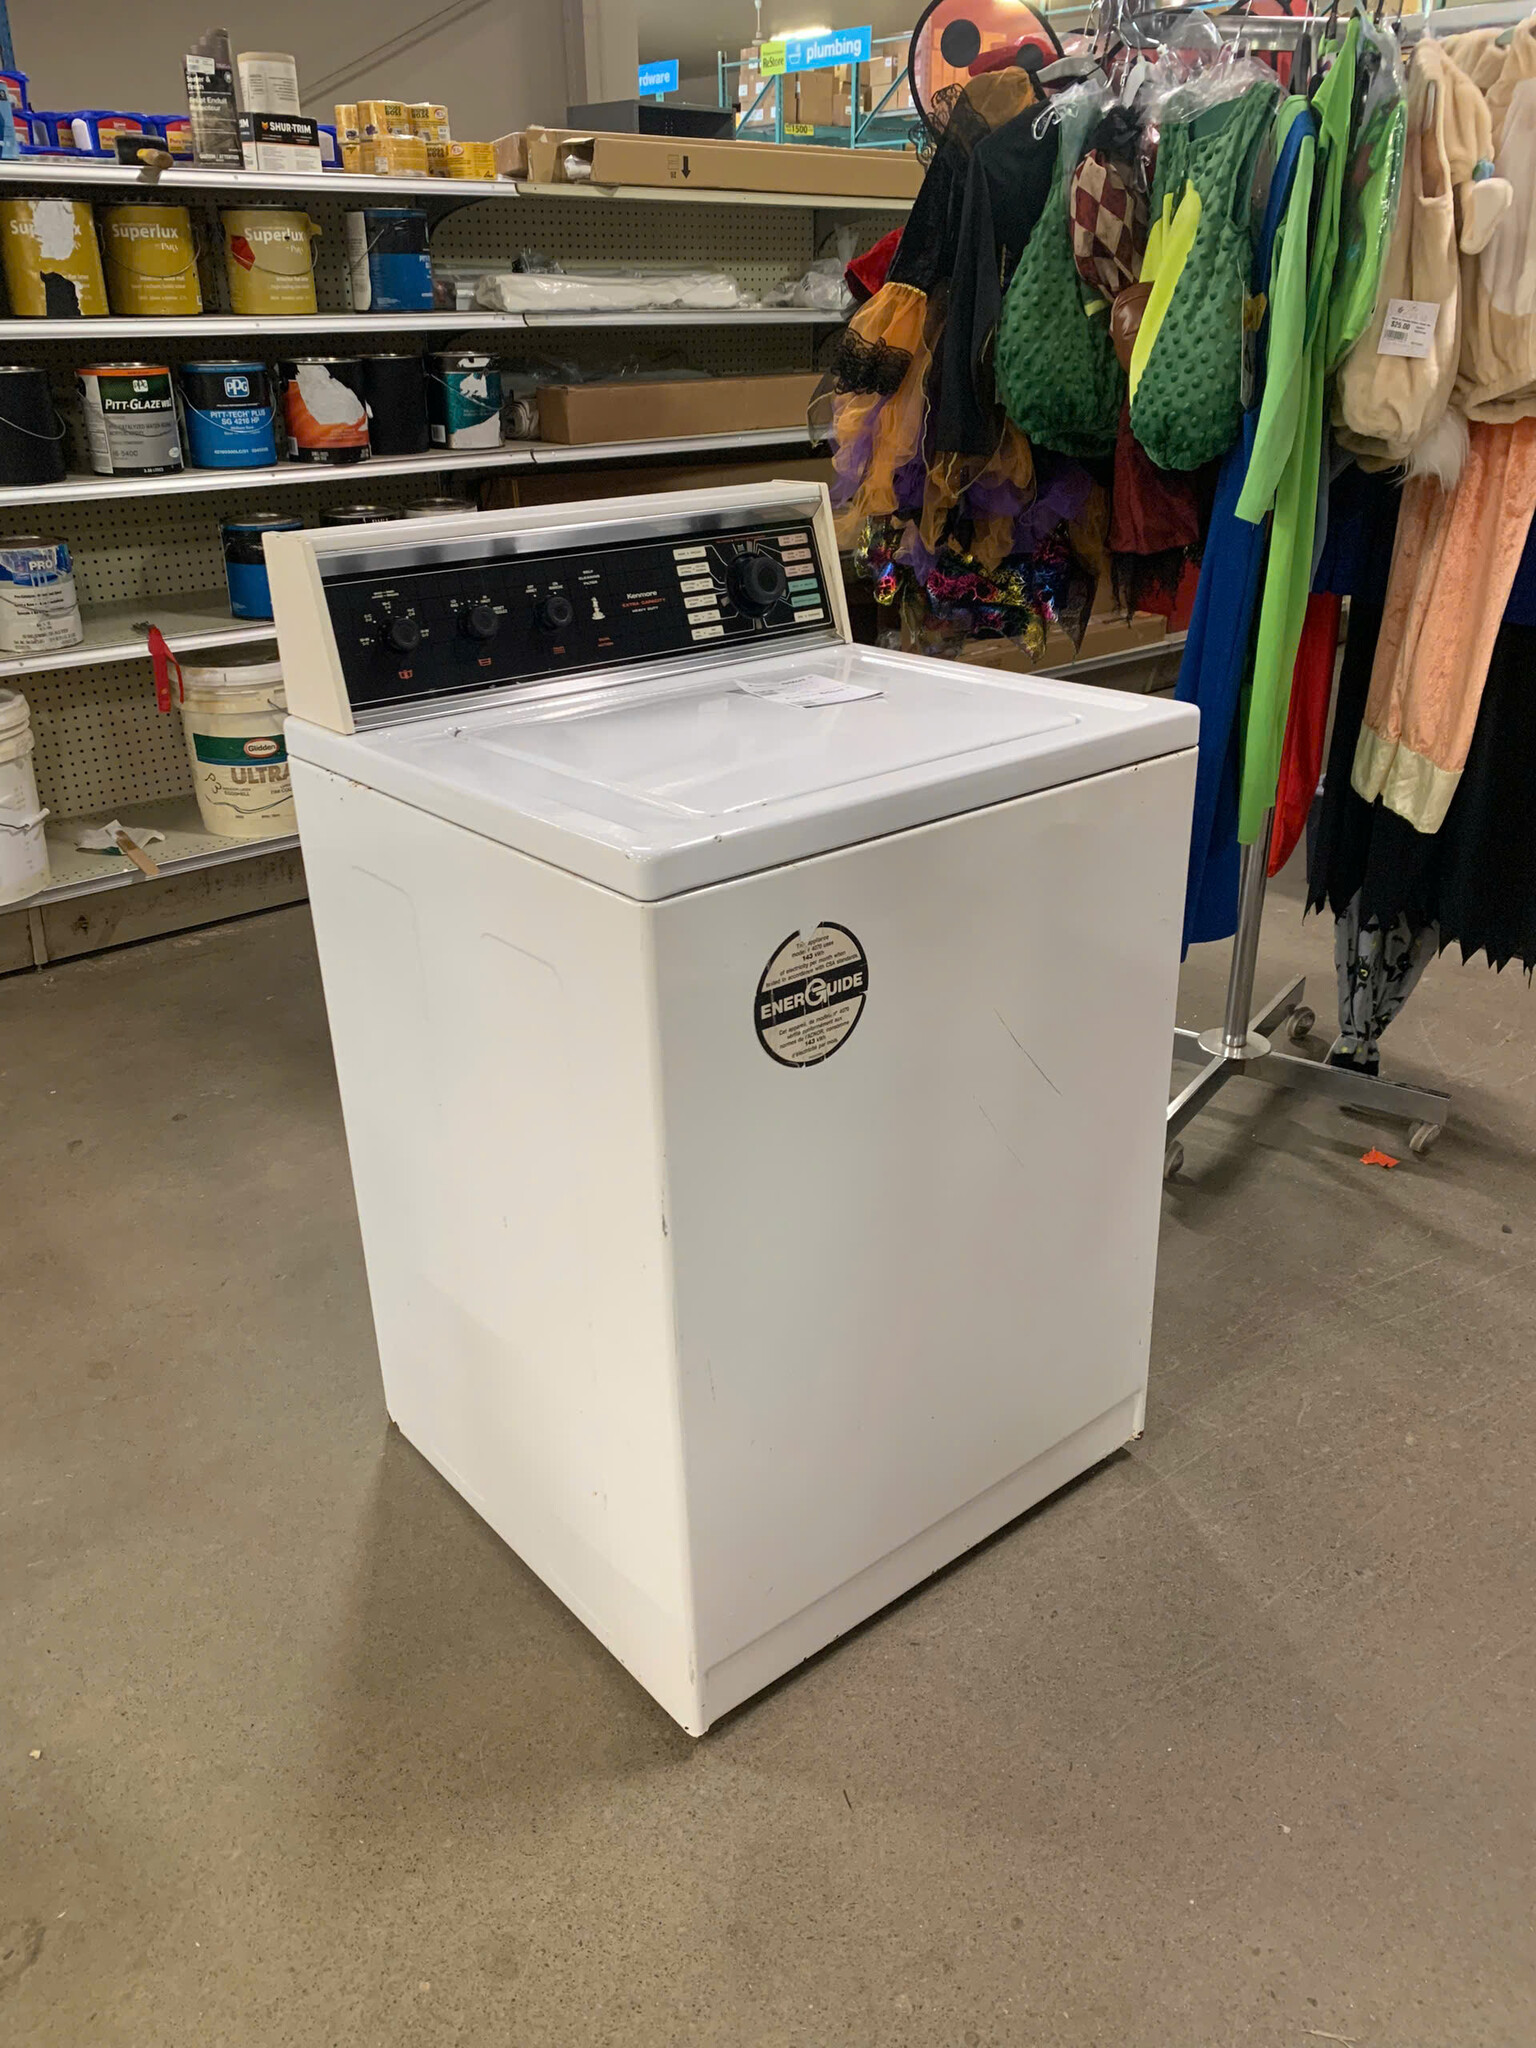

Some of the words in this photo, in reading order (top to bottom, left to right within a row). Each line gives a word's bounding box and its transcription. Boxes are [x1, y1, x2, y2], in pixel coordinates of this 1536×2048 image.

[806, 37, 862, 64] plumbing
[639, 72, 671, 87] rdware
[269, 122, 312, 134] SHUR-TRIM
[792, 124, 808, 134] 1500
[10, 219, 82, 238] Supx
[112, 223, 179, 242] Superlux
[244, 227, 304, 245] Superlux
[226, 379, 248, 396] PPG
[105, 398, 161, 410] PITT-GLAZE
[210, 410, 249, 418] PITT-TECH
[28, 559, 53, 571] PRO
[626, 590, 658, 600] Kenmore
[641, 597, 666, 605] CAPACITY
[248, 743, 276, 752] Glidden
[802, 953, 813, 961] 143
[786, 963, 809, 974] electricity
[818, 954, 833, 963] month
[788, 969, 814, 981] accordance
[825, 960, 836, 968] CSA
[805, 1038, 815, 1046] 143
